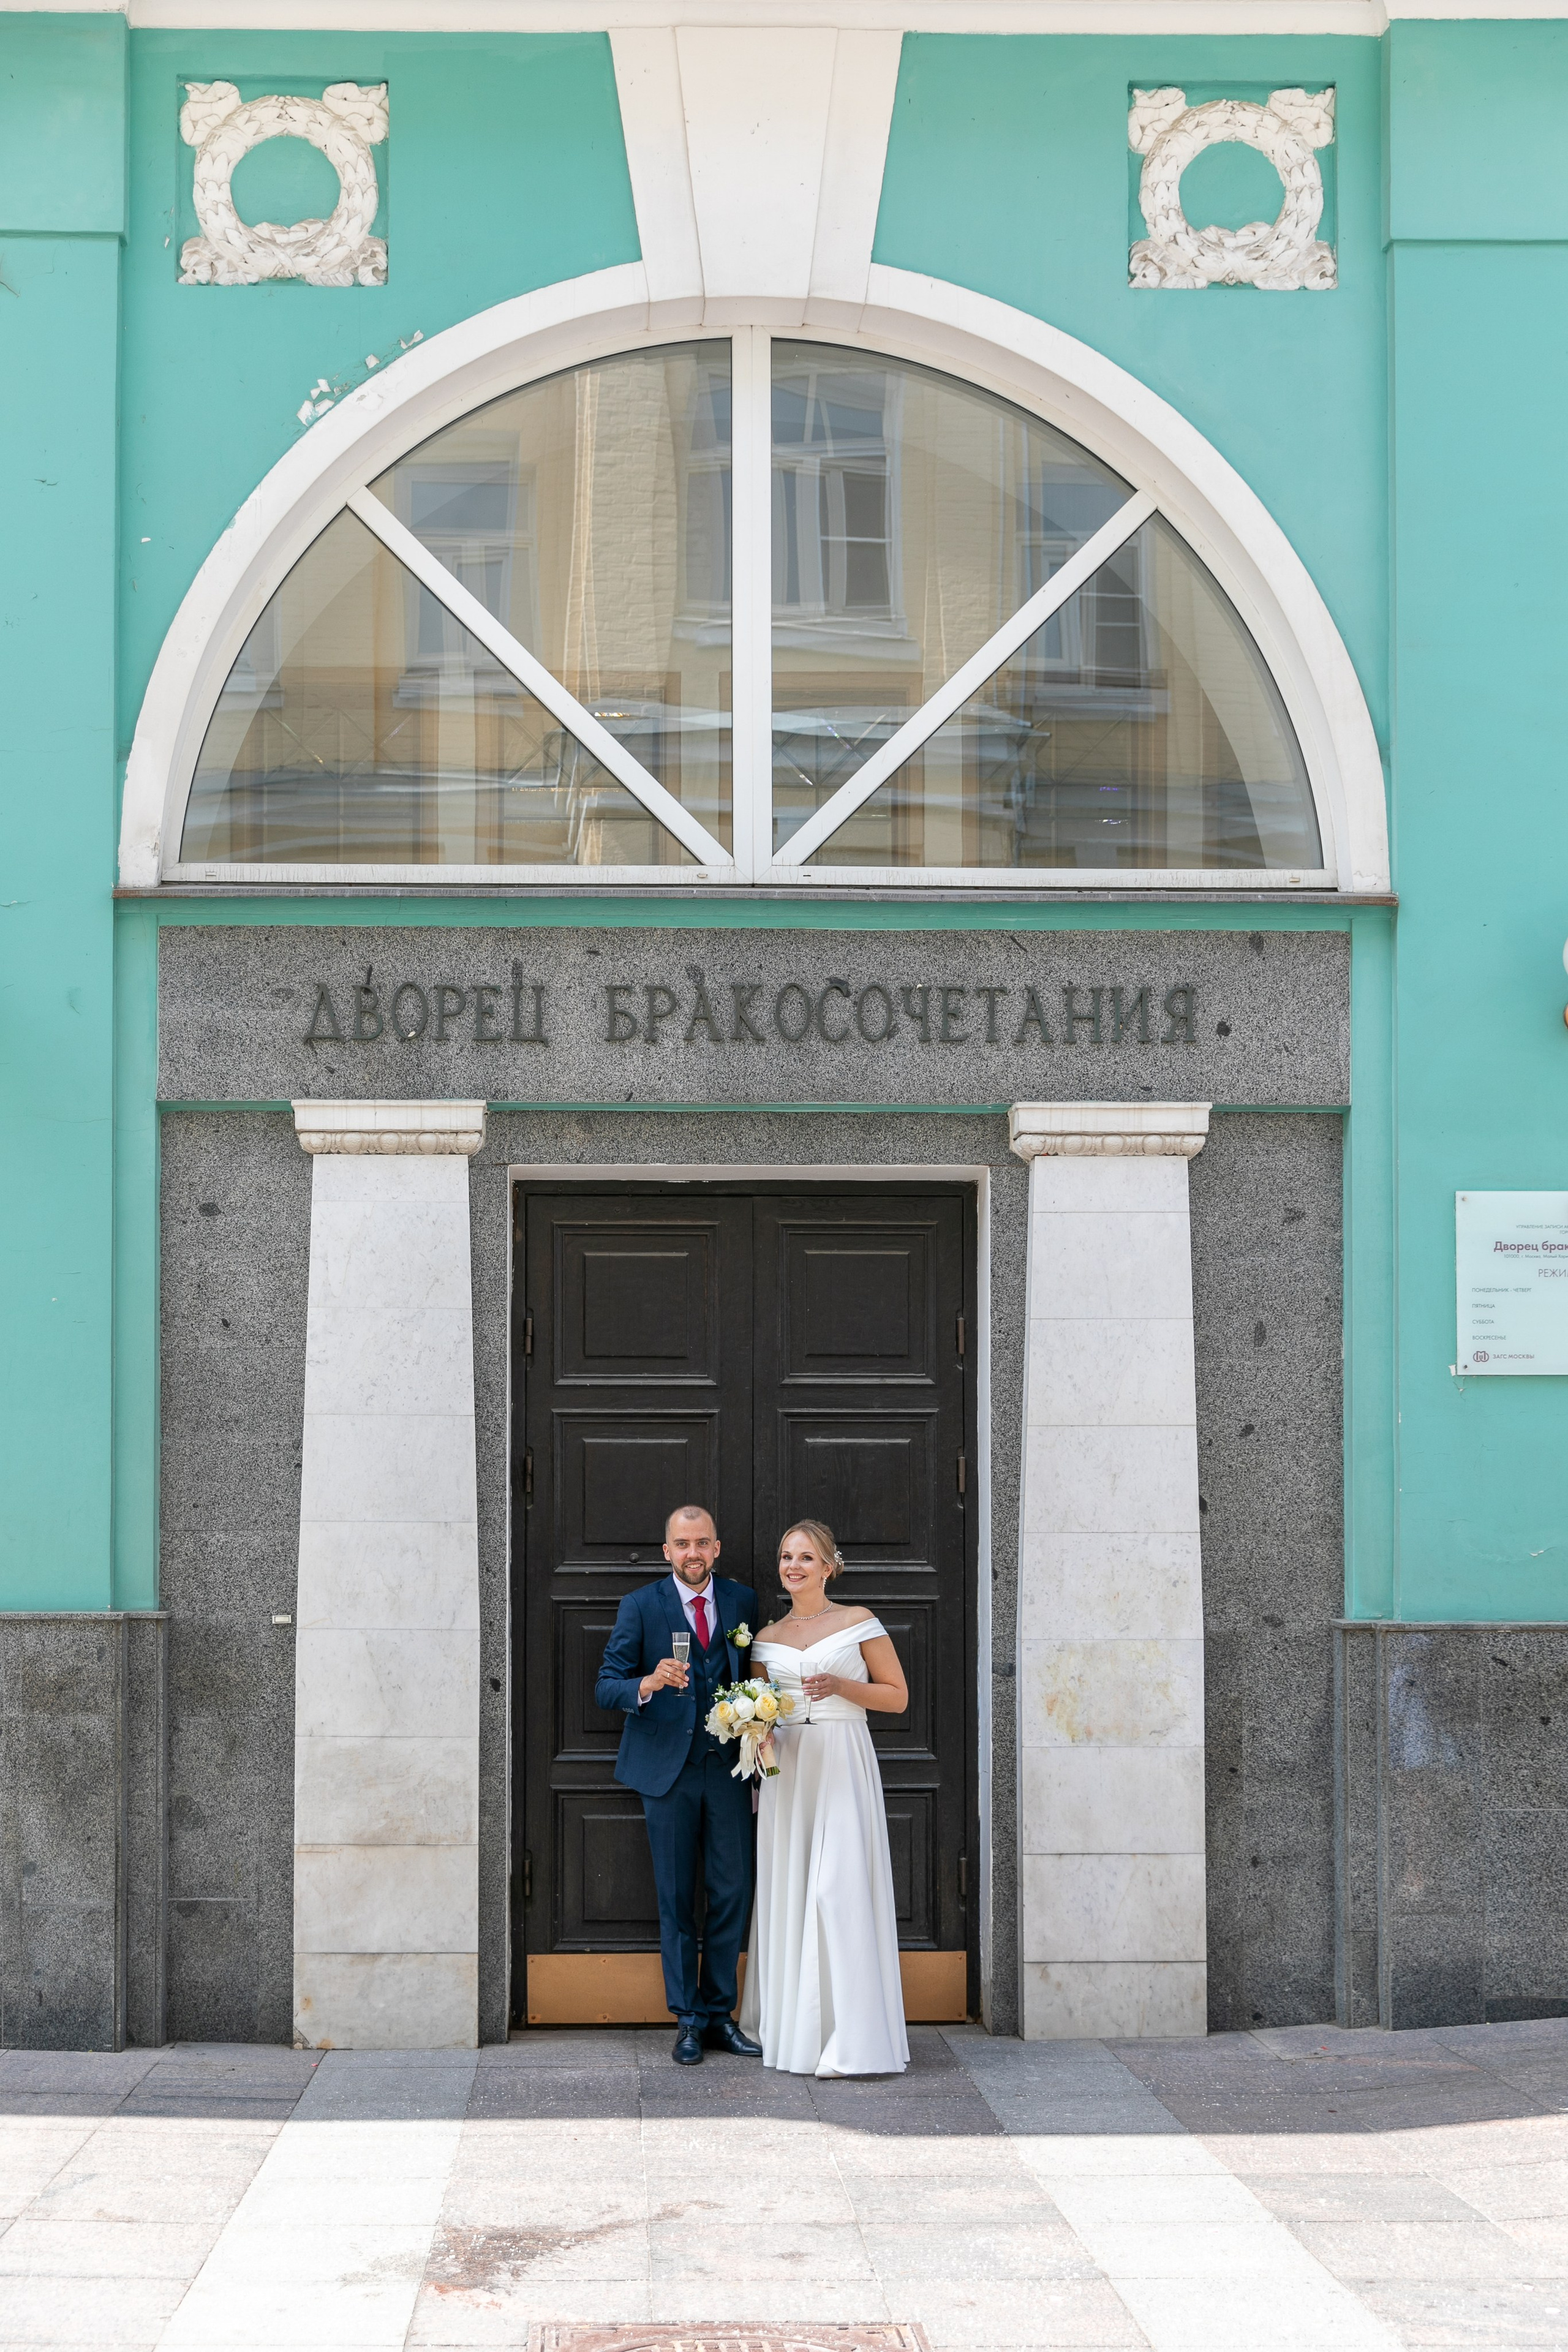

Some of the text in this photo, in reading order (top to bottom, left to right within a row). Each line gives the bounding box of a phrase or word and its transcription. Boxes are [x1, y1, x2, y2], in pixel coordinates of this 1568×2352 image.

[306, 982, 1196, 1044] ДВОРЕЦ БРАКОСОЧЕТАНИЯ
[1494, 1241, 1539, 1253] Дворец
[1538, 1268, 1568, 1277] РЕЖИ
